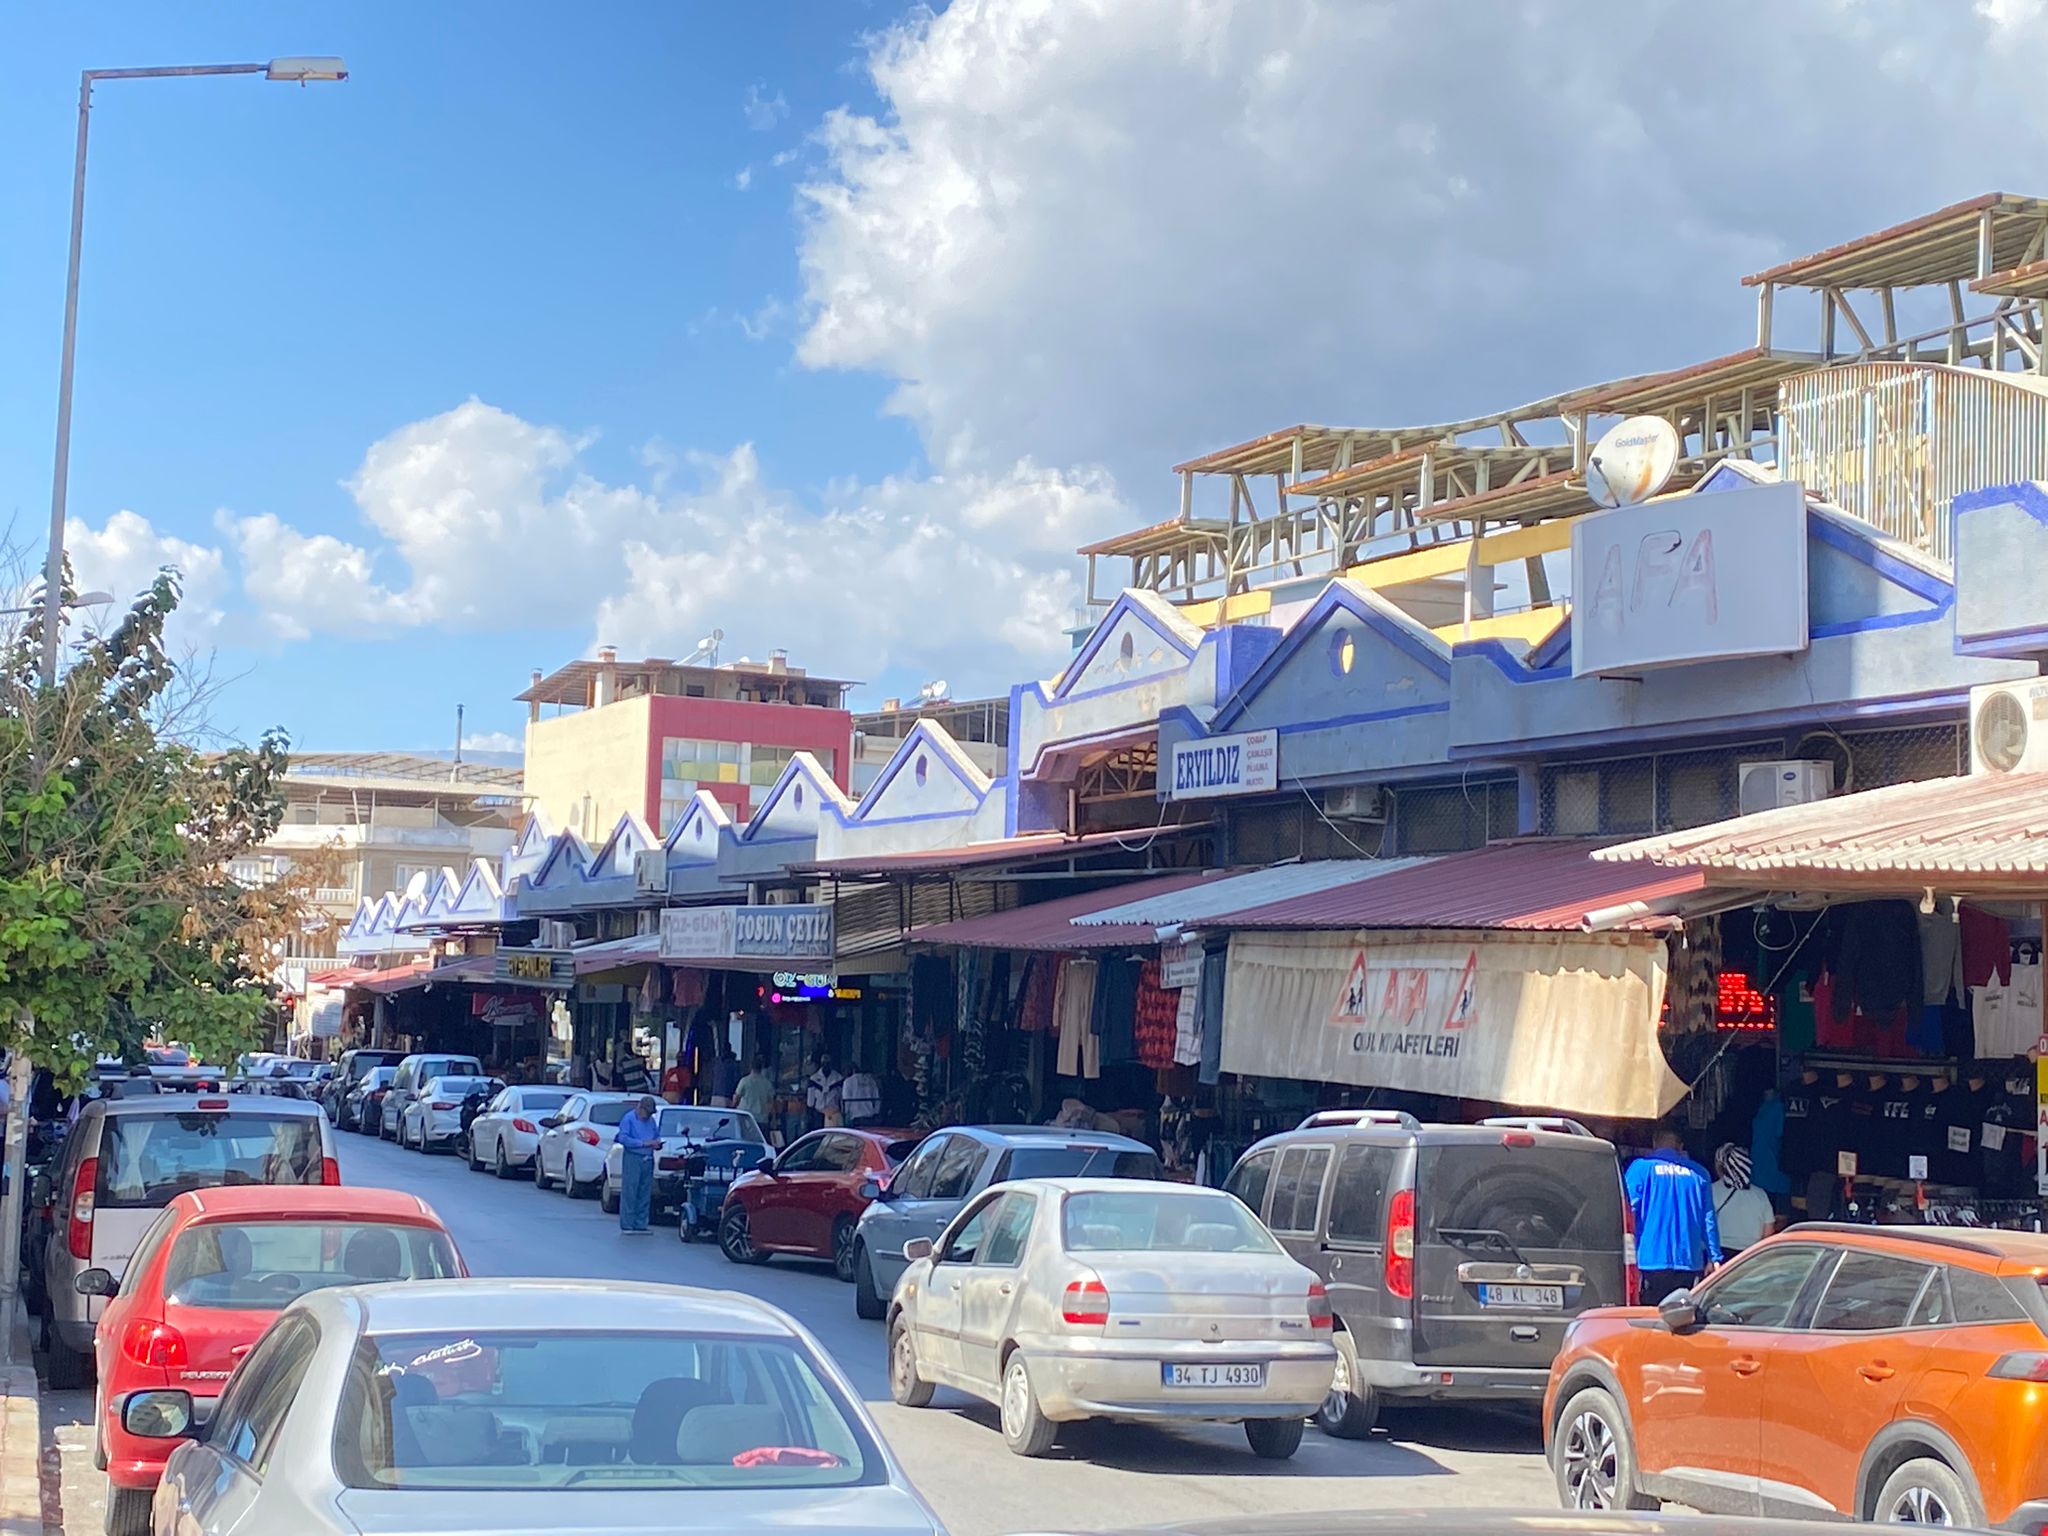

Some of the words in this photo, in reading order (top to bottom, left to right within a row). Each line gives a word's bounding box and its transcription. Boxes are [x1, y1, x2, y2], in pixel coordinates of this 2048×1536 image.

[1615, 434, 1660, 448] GoldMaster
[1589, 528, 1718, 634] AFA
[1176, 745, 1240, 790] ERYILDIZ
[737, 914, 784, 942] TOSUN
[786, 908, 830, 947] ÇEYİZ
[1488, 1288, 1502, 1302] 48
[1512, 1288, 1526, 1303] KL
[1535, 1288, 1558, 1304] 348
[1175, 1367, 1191, 1384] 34
[1201, 1367, 1218, 1384] TJ
[1225, 1367, 1259, 1384] 4930
